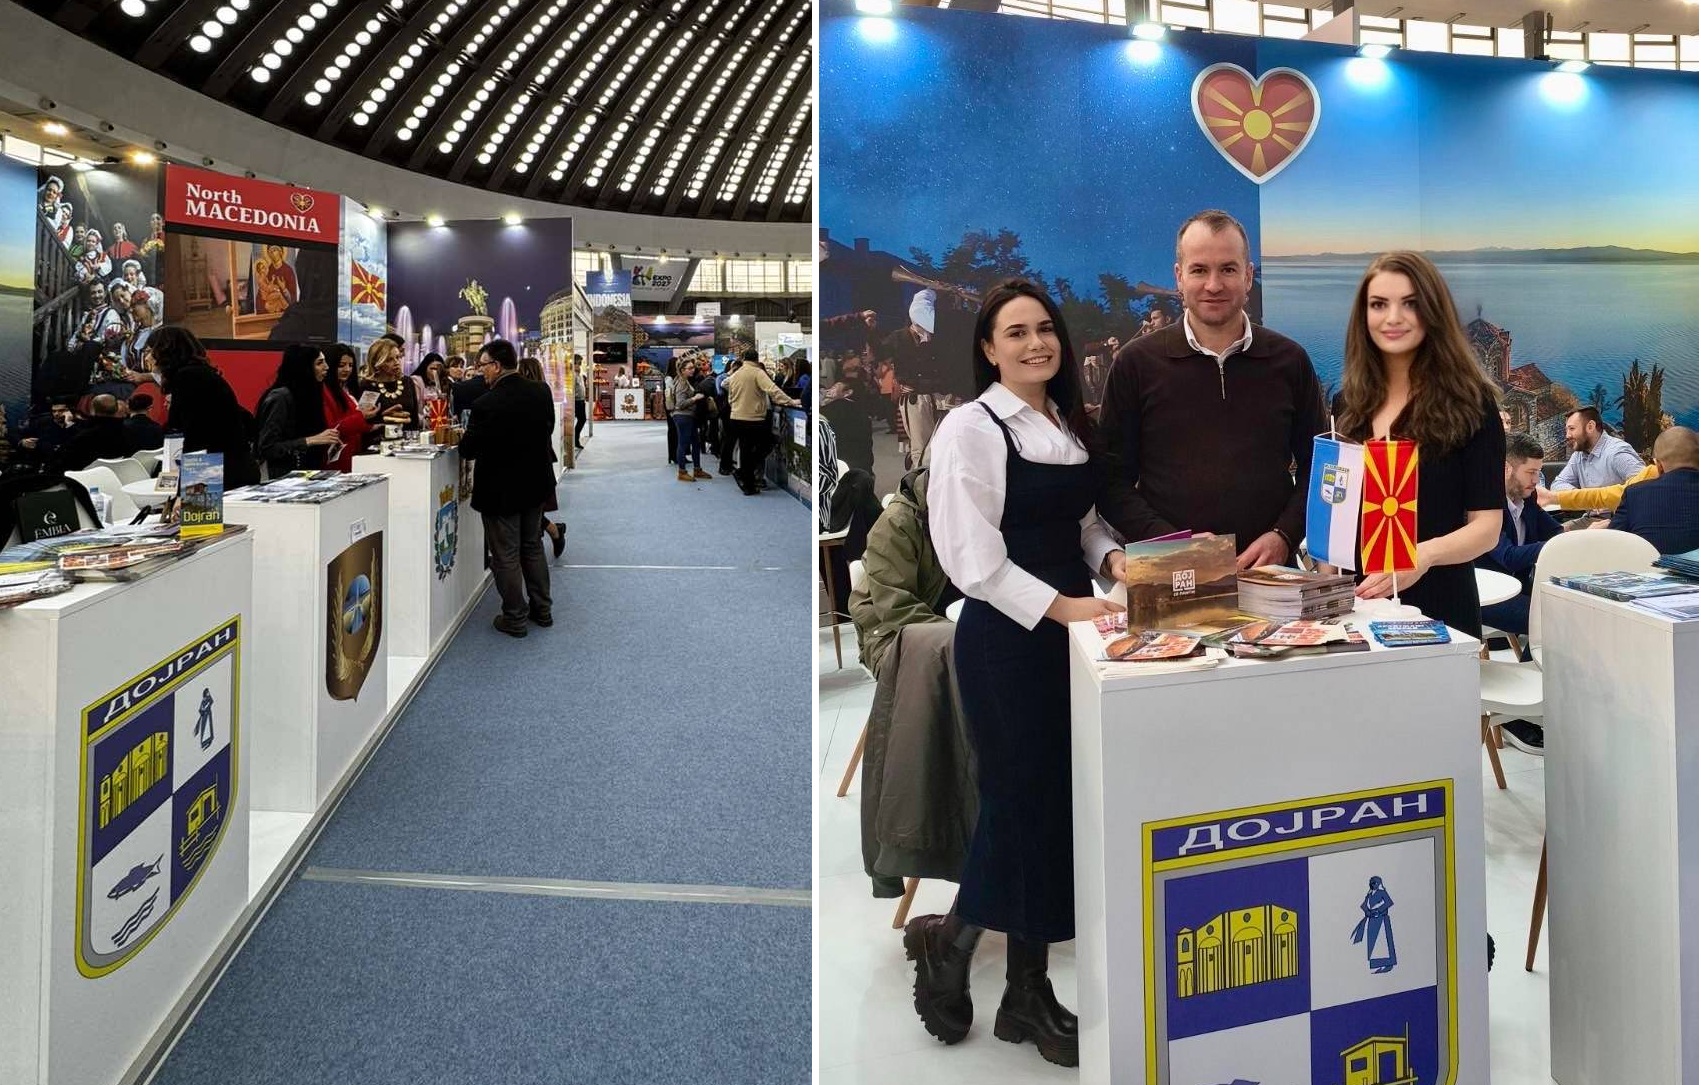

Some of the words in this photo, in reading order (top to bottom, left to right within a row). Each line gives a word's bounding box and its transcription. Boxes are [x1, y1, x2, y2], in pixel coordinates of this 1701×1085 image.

[185, 182, 242, 205] North
[185, 199, 321, 234] MACEDONIA
[586, 292, 632, 308] INDONESIA
[183, 510, 220, 523] Dojran
[1175, 571, 1193, 582] ДОЈ
[1175, 580, 1194, 589] РАН
[102, 627, 231, 724] ДОЈРАН
[1178, 793, 1428, 856] ДОЈРАН
